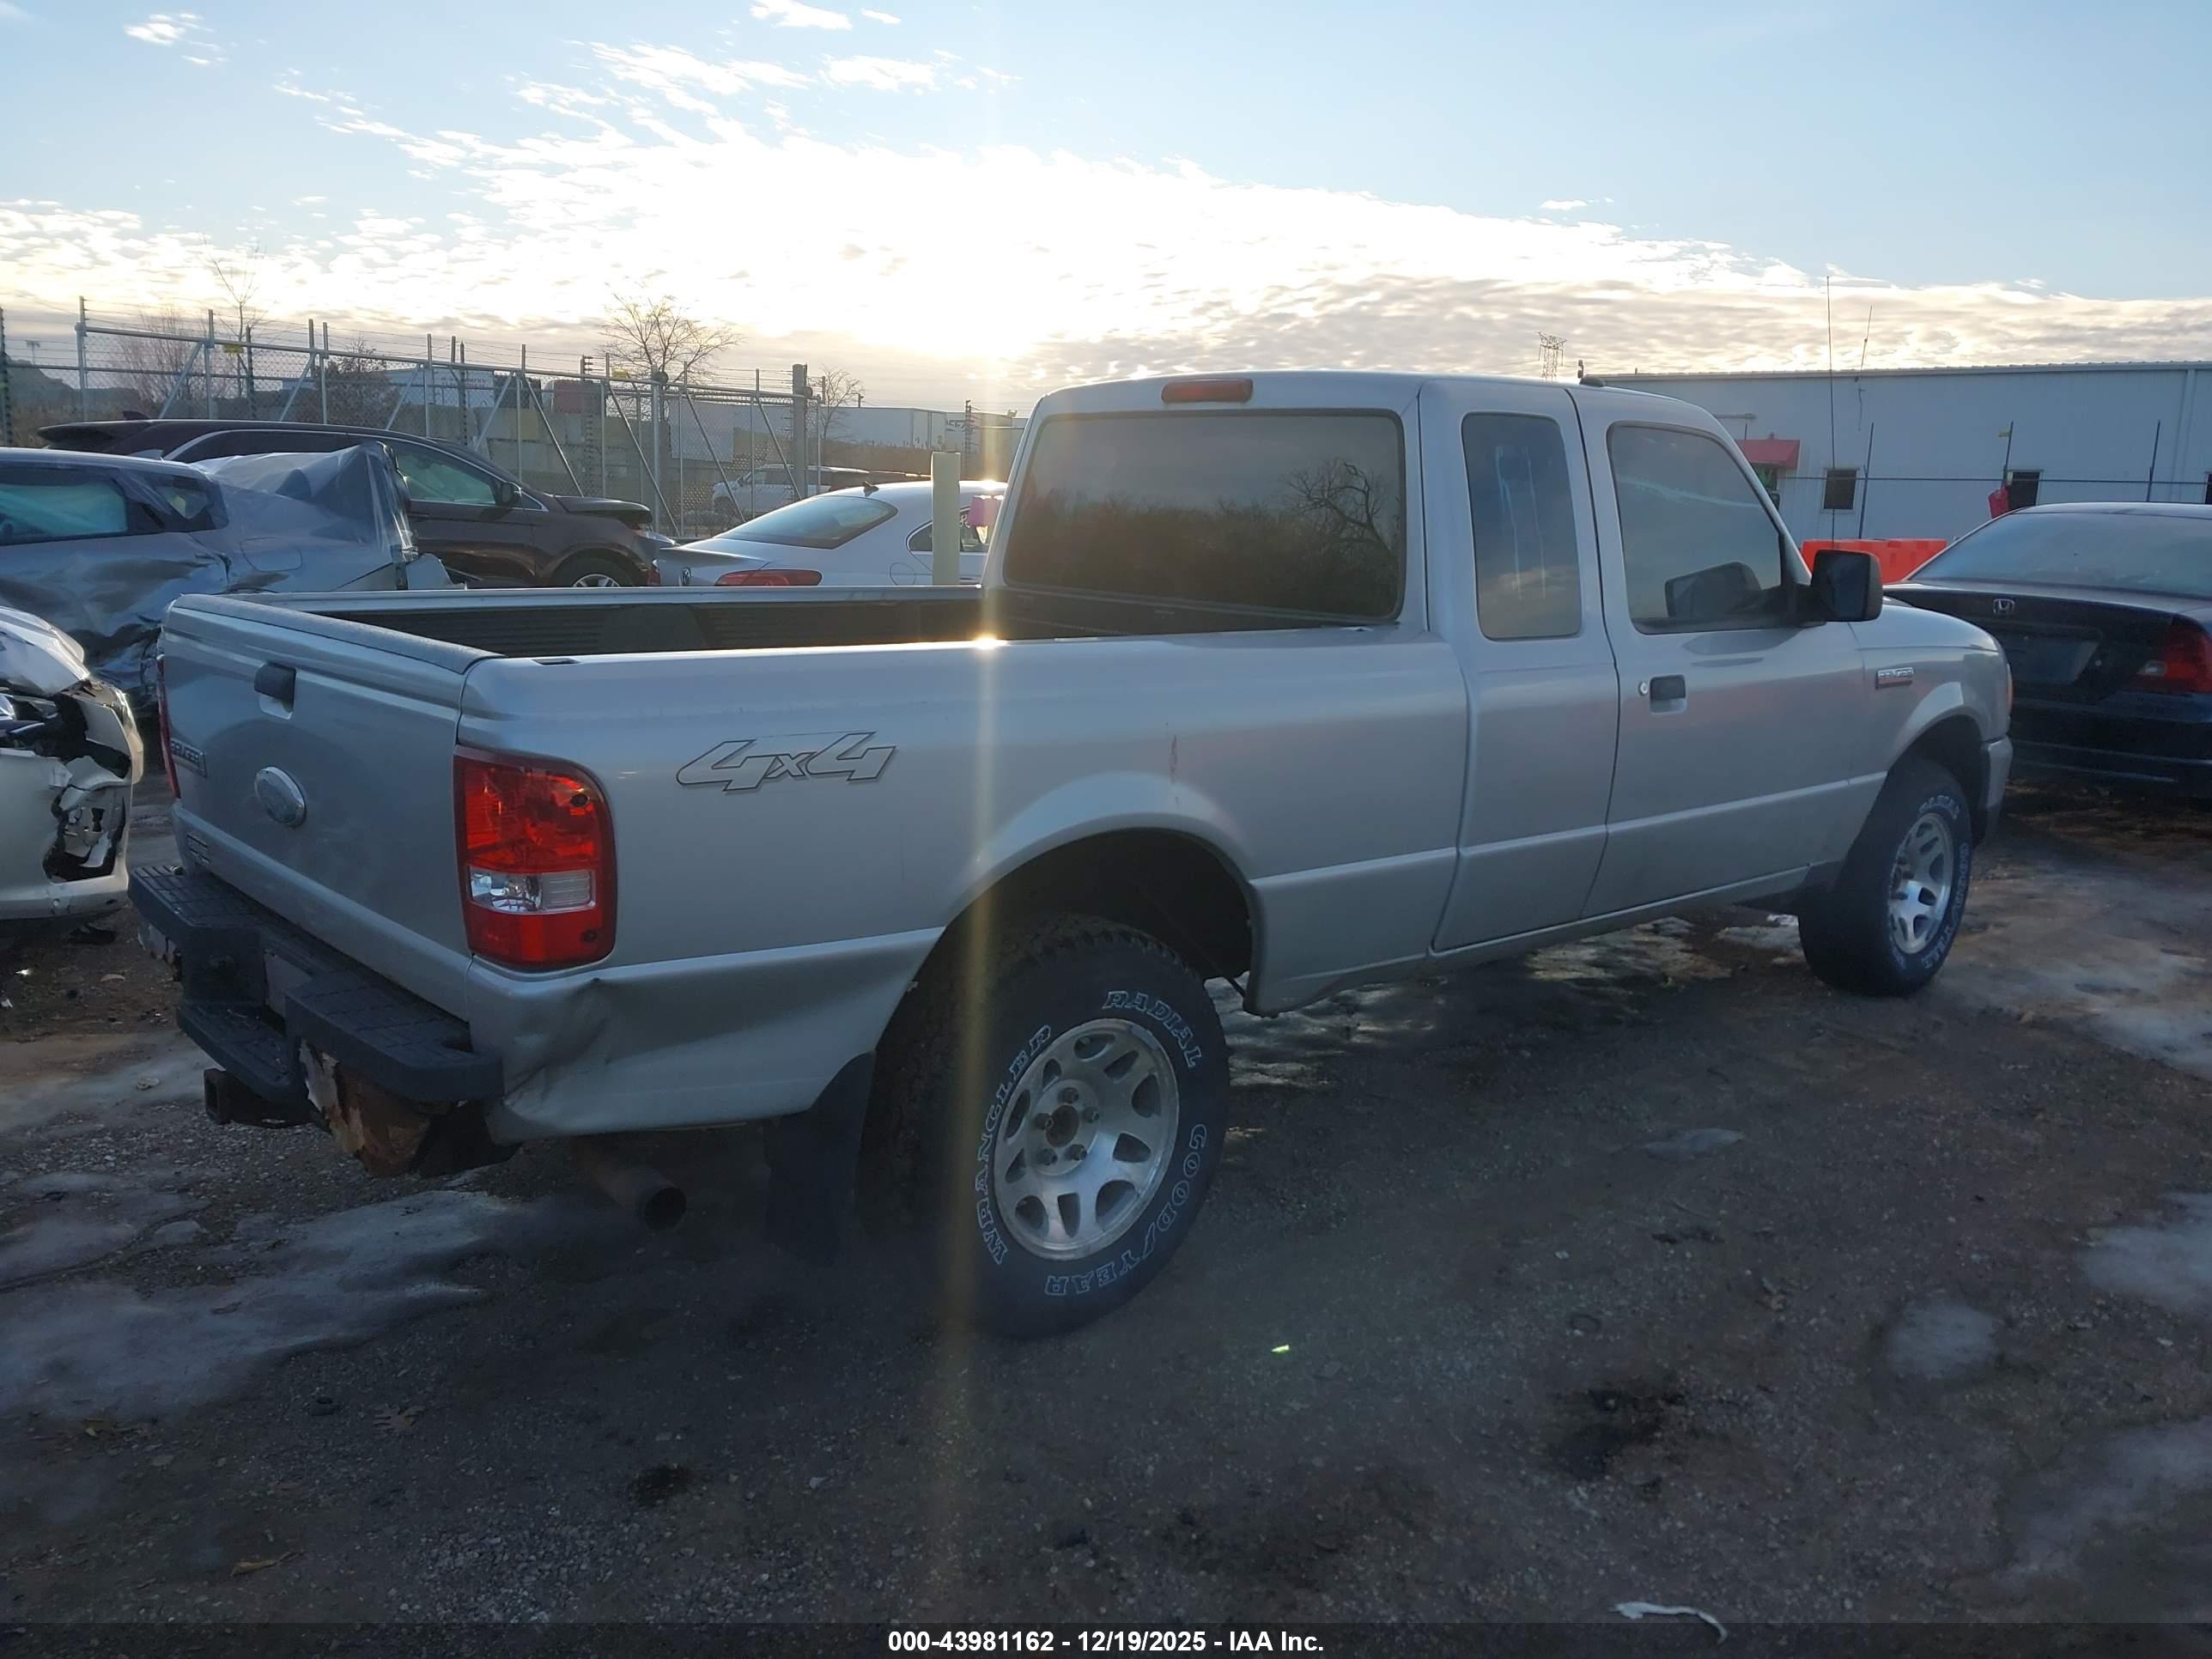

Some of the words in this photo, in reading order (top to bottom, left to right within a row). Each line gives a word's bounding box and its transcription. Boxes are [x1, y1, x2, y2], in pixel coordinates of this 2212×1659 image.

[676, 731, 896, 791] 4x4
[1102, 990, 1202, 1069] RADIAL
[975, 1024, 1051, 1265] WRANGLER
